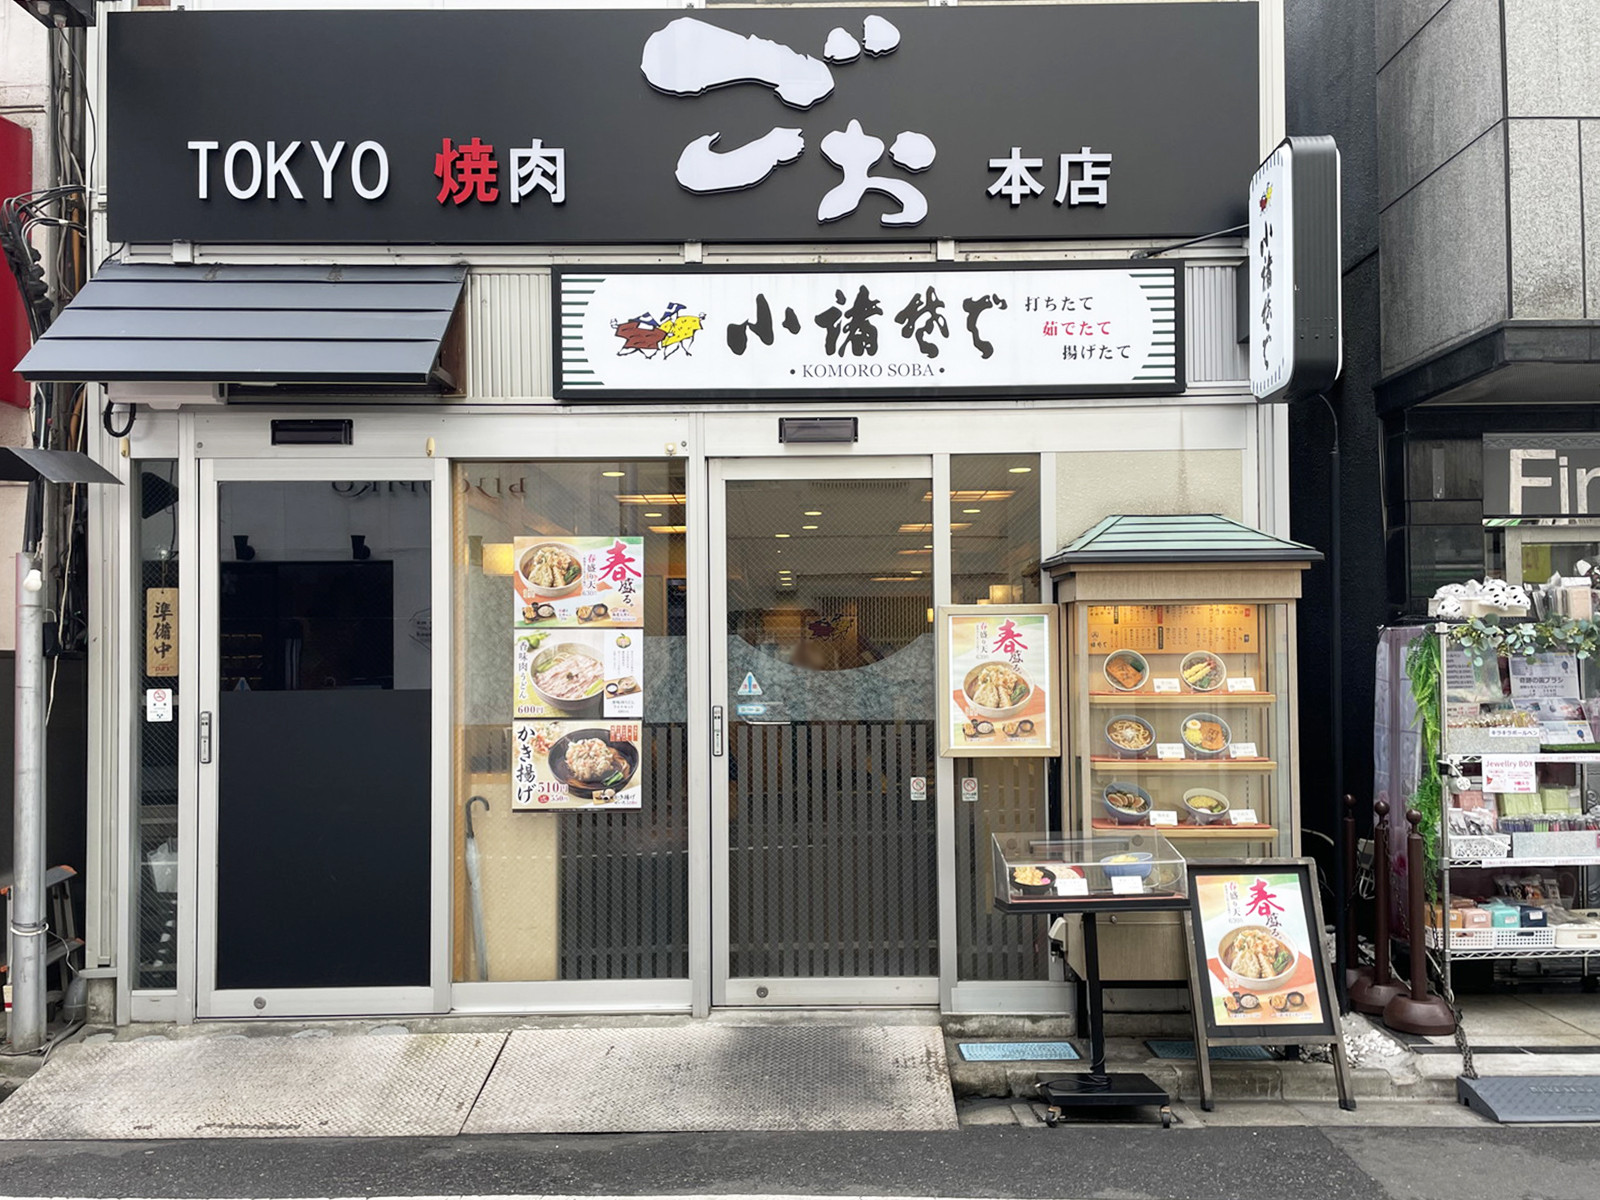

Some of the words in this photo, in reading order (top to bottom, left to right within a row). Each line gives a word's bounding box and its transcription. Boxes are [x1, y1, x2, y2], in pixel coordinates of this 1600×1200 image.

[187, 140, 389, 201] TOKYO
[433, 137, 566, 208] 焼肉
[987, 146, 1113, 207] 本店
[1024, 296, 1094, 312] 打ちたて
[1042, 320, 1112, 337] 茹でたて
[1062, 344, 1132, 361] 揚げたて
[802, 364, 883, 378] KOMORO
[887, 363, 935, 377] SOBA
[152, 601, 174, 659] 準備中
[517, 705, 544, 714] 600円
[516, 726, 537, 803] かき揚げ
[537, 782, 569, 793] 510円
